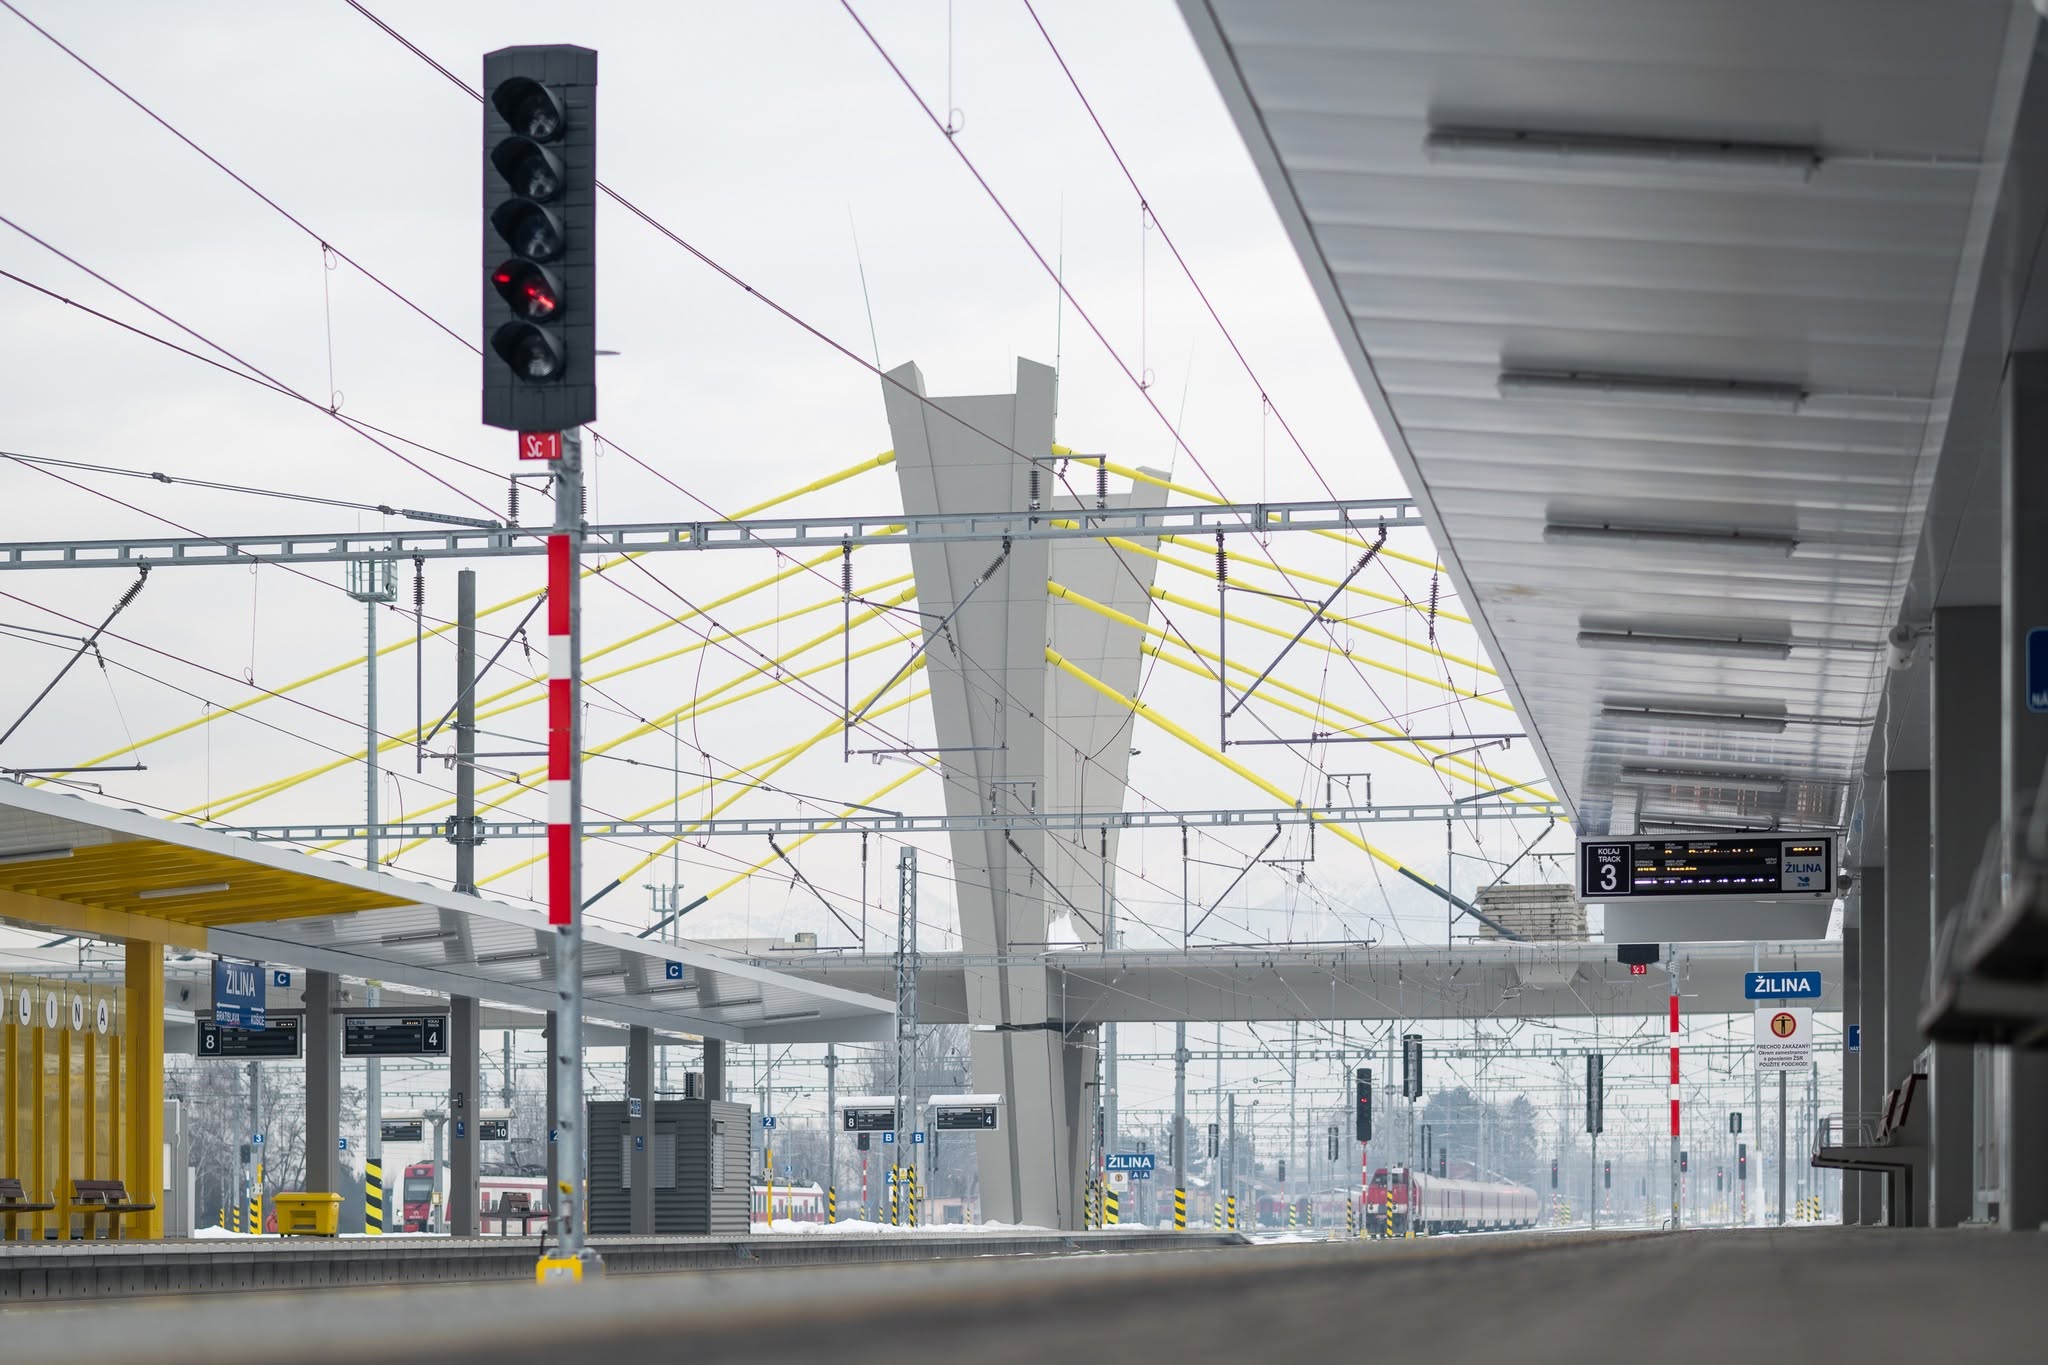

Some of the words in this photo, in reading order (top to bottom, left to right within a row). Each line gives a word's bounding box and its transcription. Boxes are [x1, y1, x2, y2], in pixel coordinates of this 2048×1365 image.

[527, 434, 543, 458] Sc
[547, 434, 556, 457] 1
[1598, 847, 1620, 855] KOĽAJ
[1784, 861, 1823, 873] ŽILINA
[1600, 864, 1617, 891] 3
[669, 965, 679, 977] C
[225, 964, 256, 997] ŽILINA
[277, 973, 287, 984] C
[1754, 975, 1811, 993] ŽILINA
[206, 1034, 215, 1049] 8
[428, 1031, 438, 1046] 4
[765, 1117, 772, 1126] 2
[848, 1118, 854, 1127] 8
[985, 1116, 992, 1124] 4
[496, 1128, 507, 1137] 10
[885, 1133, 892, 1142] B
[915, 1133, 922, 1142] B
[256, 1134, 262, 1143] 3
[1108, 1154, 1151, 1168] ŽILINA
